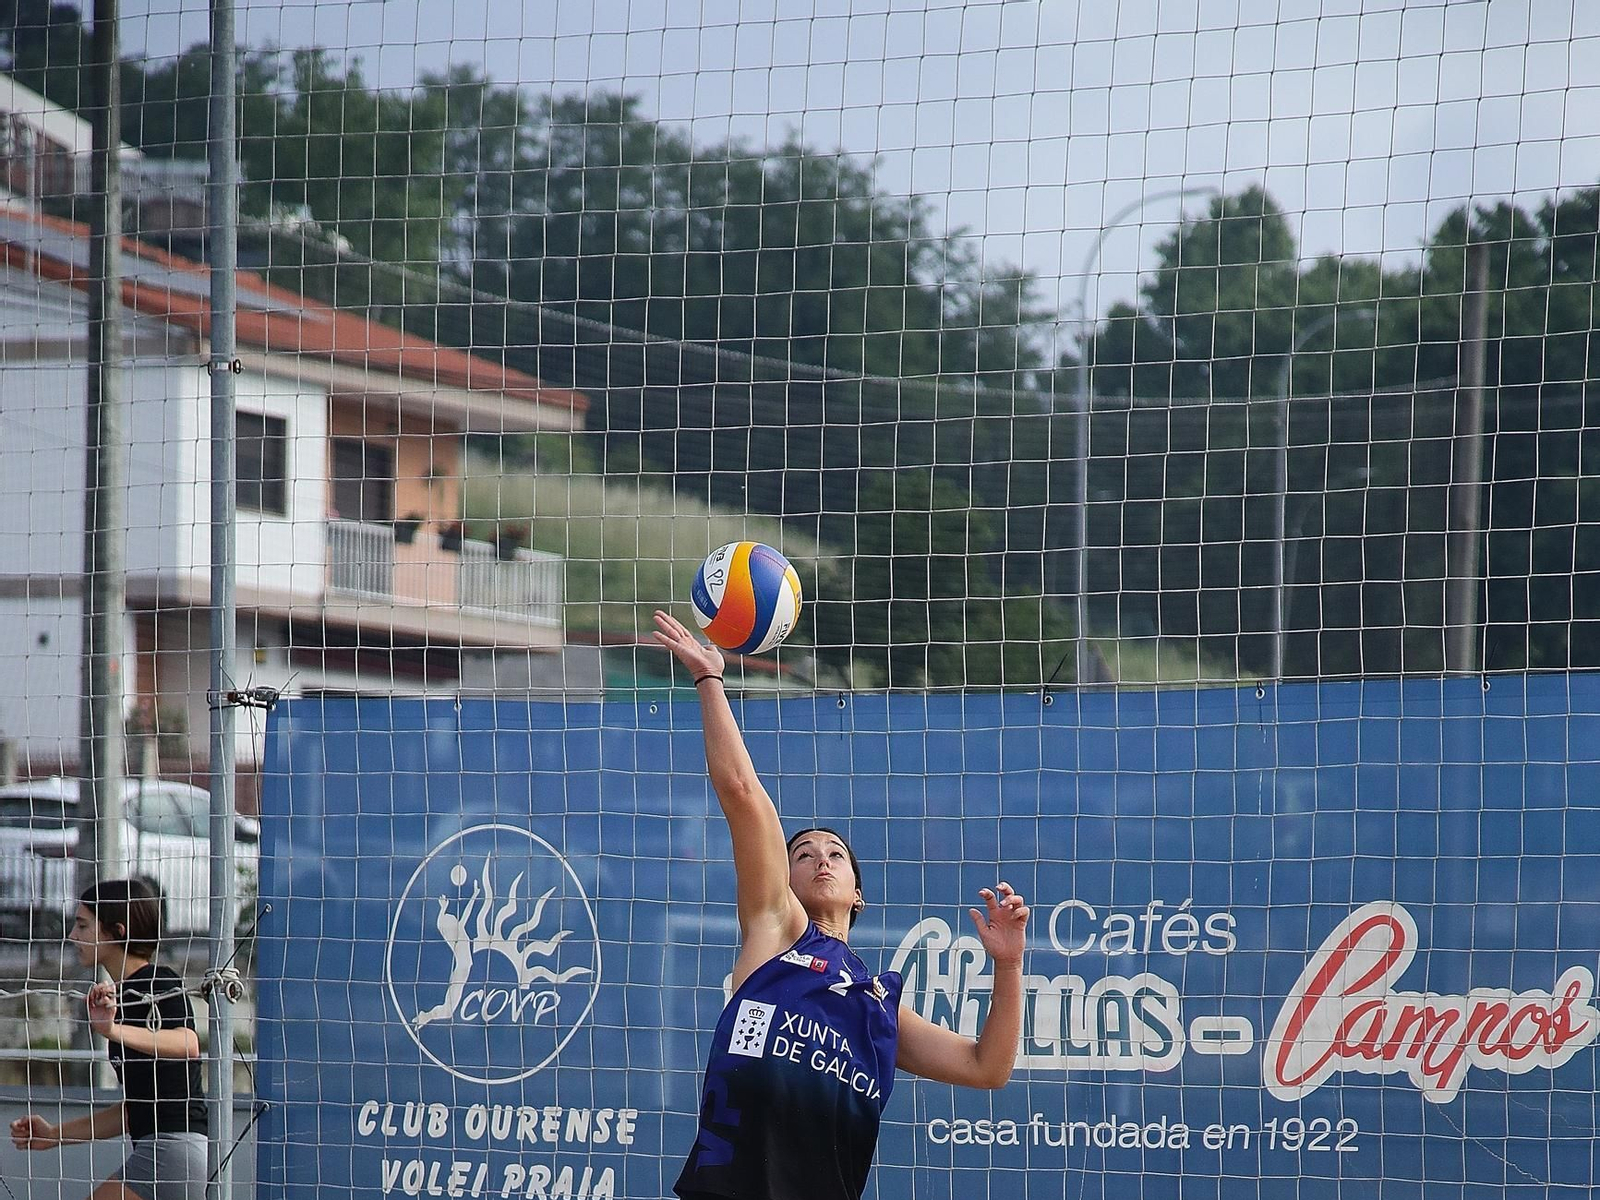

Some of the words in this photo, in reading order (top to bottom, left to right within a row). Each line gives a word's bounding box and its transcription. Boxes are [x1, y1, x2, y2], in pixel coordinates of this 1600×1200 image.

[1049, 898, 1238, 957] Cafés
[828, 969, 853, 997] 2
[884, 917, 1186, 1072] ANTLLAS
[1266, 903, 1597, 1100] Campos
[461, 988, 560, 1024] COVP
[772, 1036, 806, 1064] DE
[778, 1011, 853, 1058] XUNTA
[357, 1100, 449, 1138] CLUB
[464, 1104, 638, 1145] OURENSE
[927, 1117, 1020, 1146] casa
[1033, 1112, 1191, 1150] fundada
[1203, 1122, 1250, 1150] en
[1264, 1117, 1360, 1153] 1922
[381, 1159, 488, 1197] VOLEI
